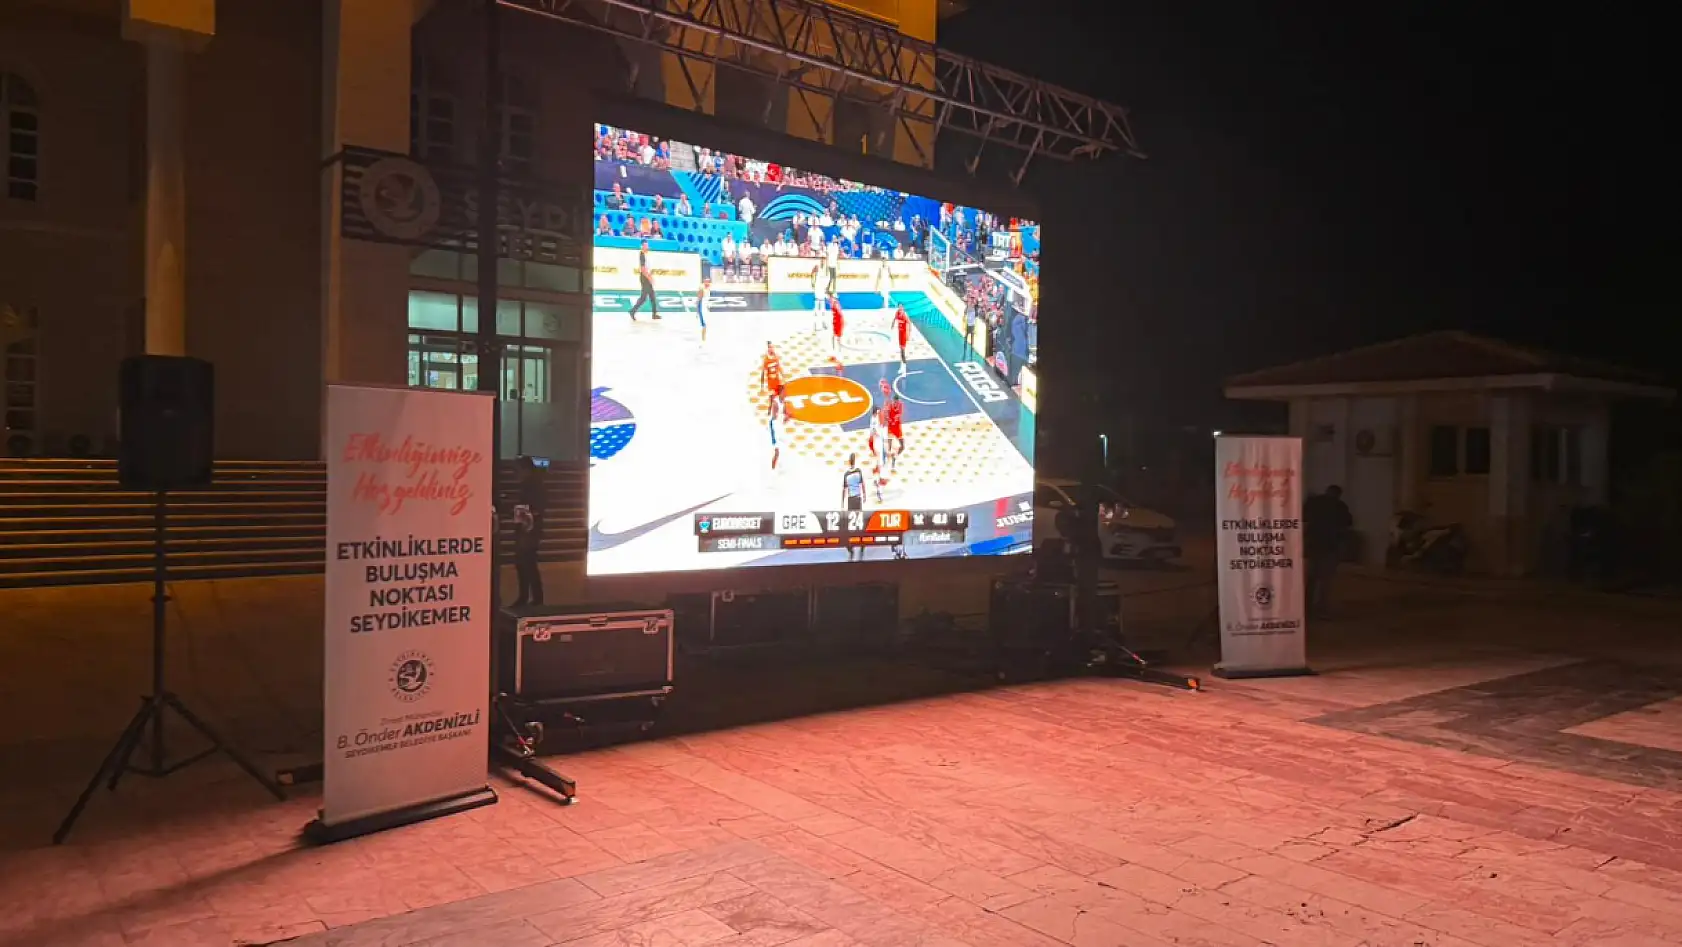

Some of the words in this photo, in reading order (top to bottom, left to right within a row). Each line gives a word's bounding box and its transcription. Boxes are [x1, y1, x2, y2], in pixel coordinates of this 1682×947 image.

[953, 361, 1008, 403] RIGA
[784, 391, 864, 409] TCL
[782, 514, 807, 529] GRE
[825, 511, 840, 531] 12
[847, 511, 864, 531] 24
[879, 512, 902, 528] TUR
[1222, 516, 1299, 530] ETKİNLİKLERDE
[337, 534, 484, 560] ETKİNLİKLERDE
[1240, 545, 1284, 556] NOKTASI
[366, 561, 459, 584] BULUŞMA
[1230, 556, 1292, 570] SEYDİKEMER
[369, 584, 453, 607] NOKTASI
[350, 606, 470, 633] SEYDİKEMER
[336, 734, 351, 749] B.
[354, 728, 401, 746] Önder
[402, 708, 480, 738] AKDENİZLİ
